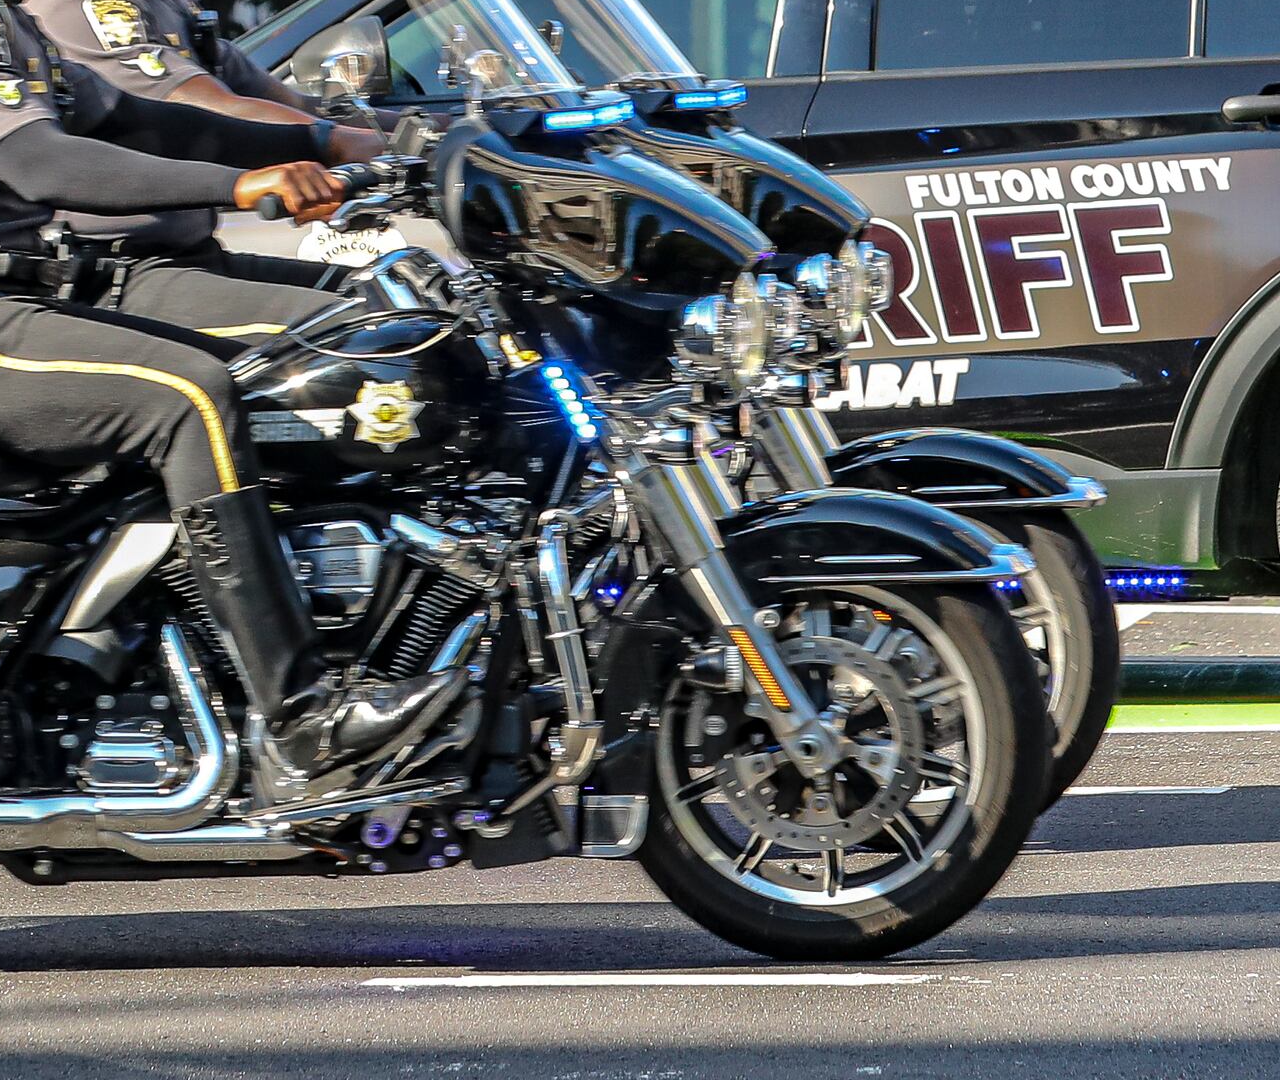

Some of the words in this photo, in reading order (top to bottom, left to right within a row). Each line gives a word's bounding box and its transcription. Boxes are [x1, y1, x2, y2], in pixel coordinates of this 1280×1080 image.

[904, 166, 1065, 208] FULTON
[1070, 157, 1232, 198] COUNTY
[846, 198, 1174, 348] RIFF
[812, 358, 970, 411] ABAT
